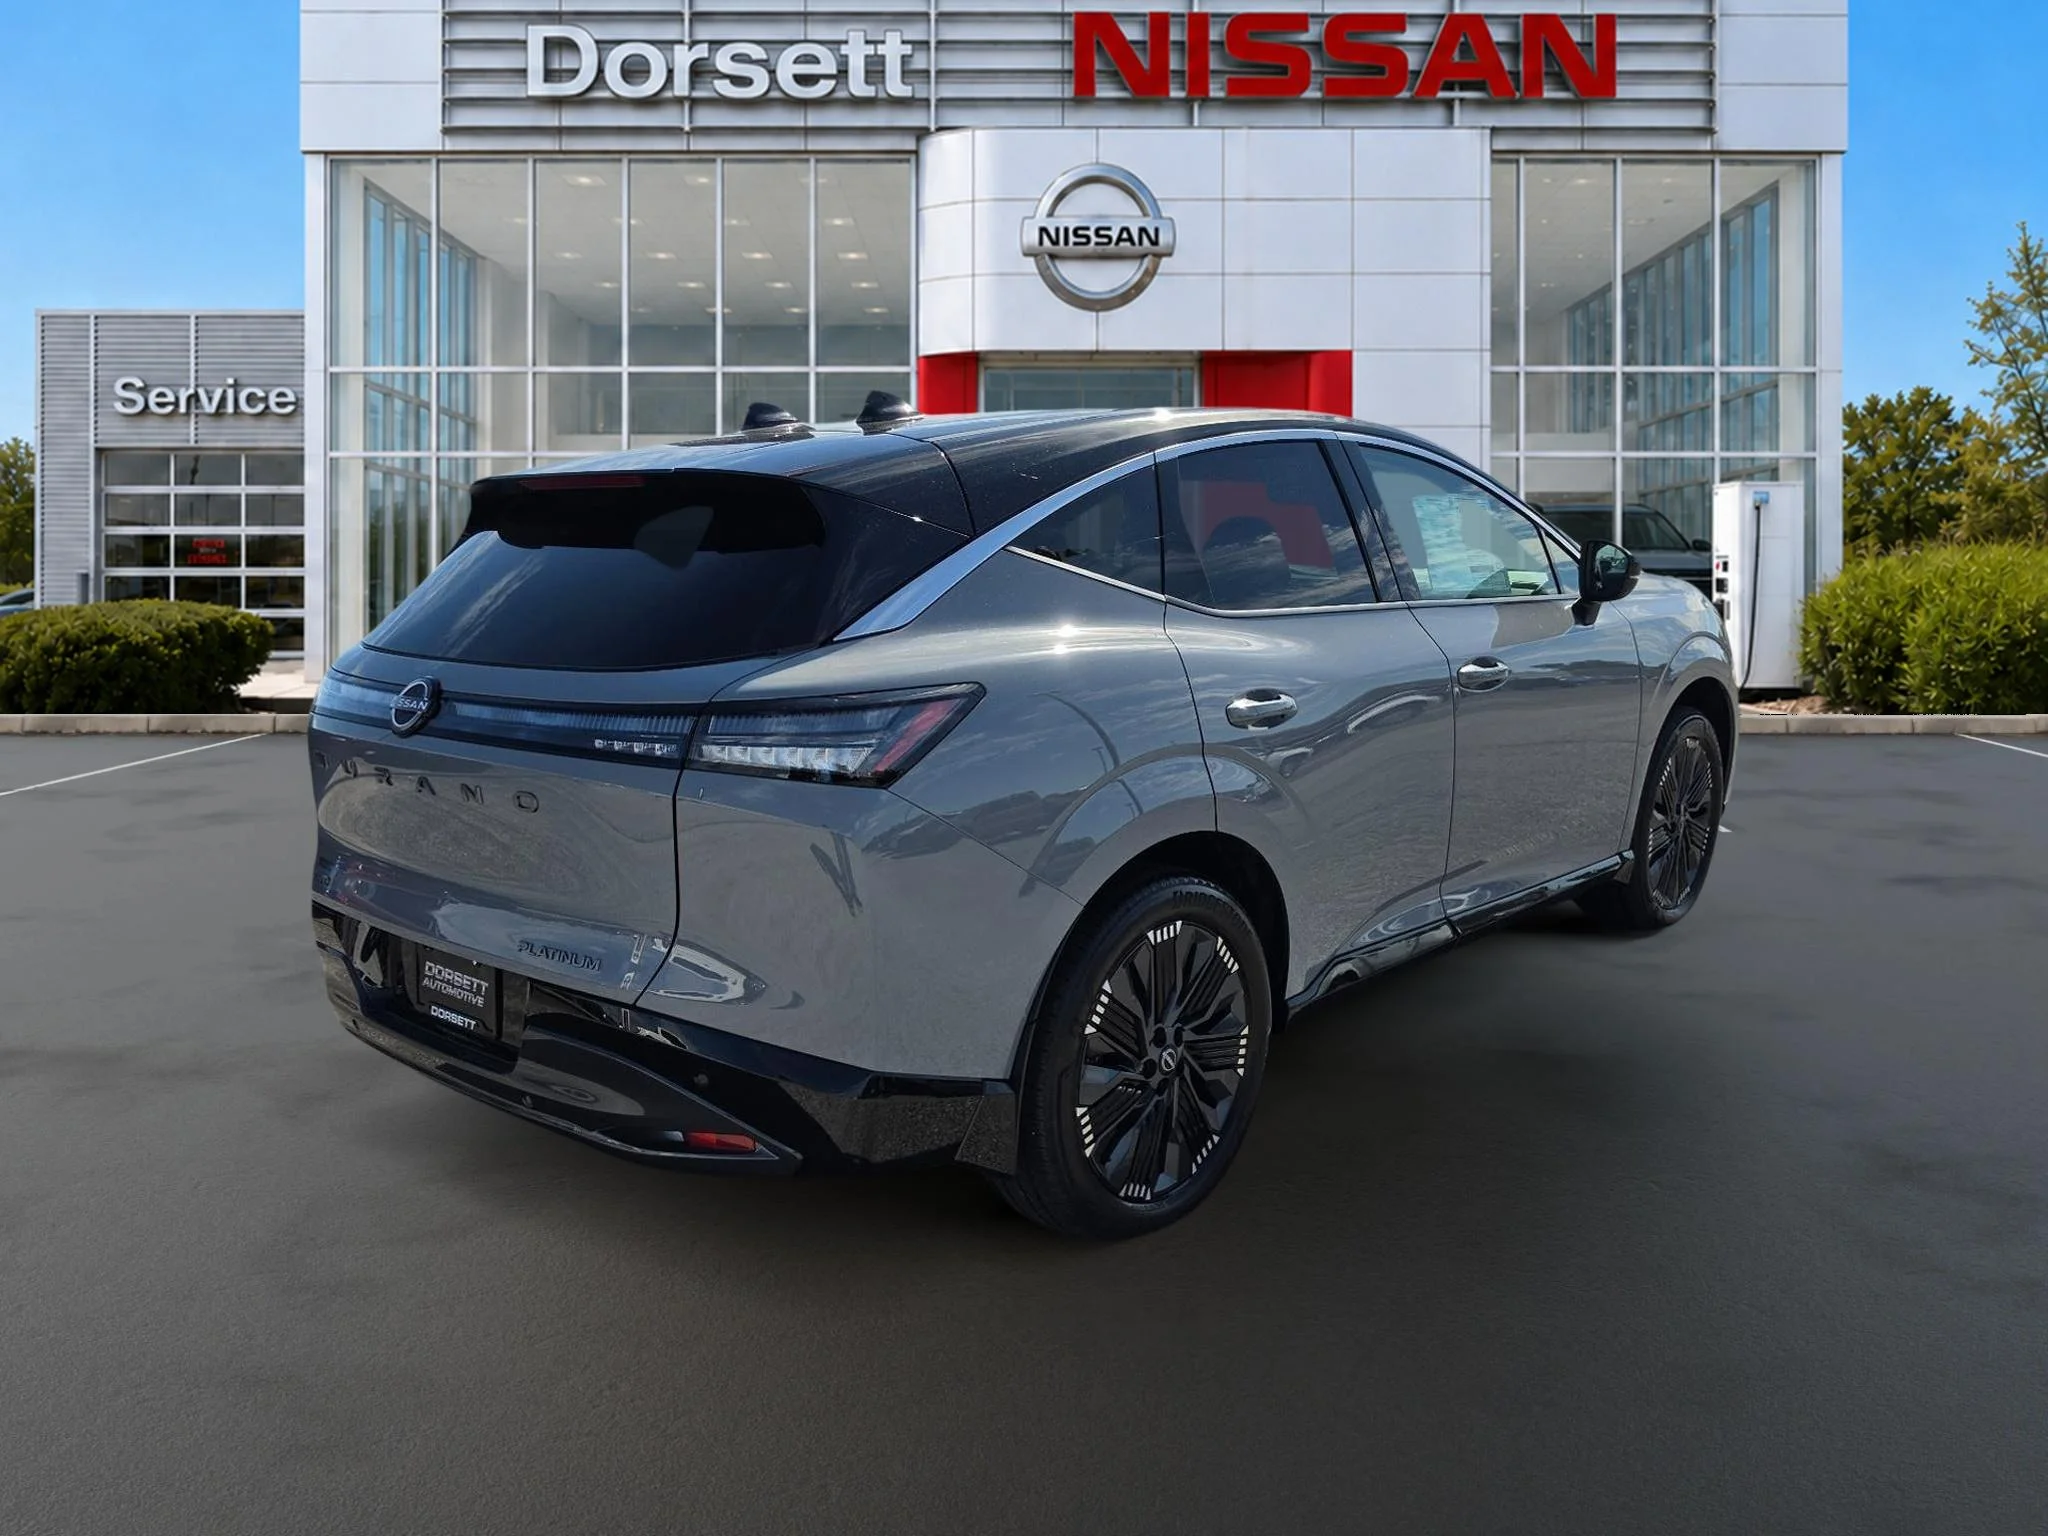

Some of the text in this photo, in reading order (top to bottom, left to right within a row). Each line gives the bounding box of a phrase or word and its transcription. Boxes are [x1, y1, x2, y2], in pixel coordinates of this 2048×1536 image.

[526, 24, 914, 99] Dorsett
[1072, 11, 1617, 98] NISSAN
[1038, 226, 1160, 247] NISSAN
[113, 376, 298, 416] Service
[517, 939, 602, 972] PLATINUM
[422, 976, 485, 1008] AUTOMOTIVE
[424, 960, 489, 995] DORSETT
[431, 1005, 477, 1031] DORSETT
